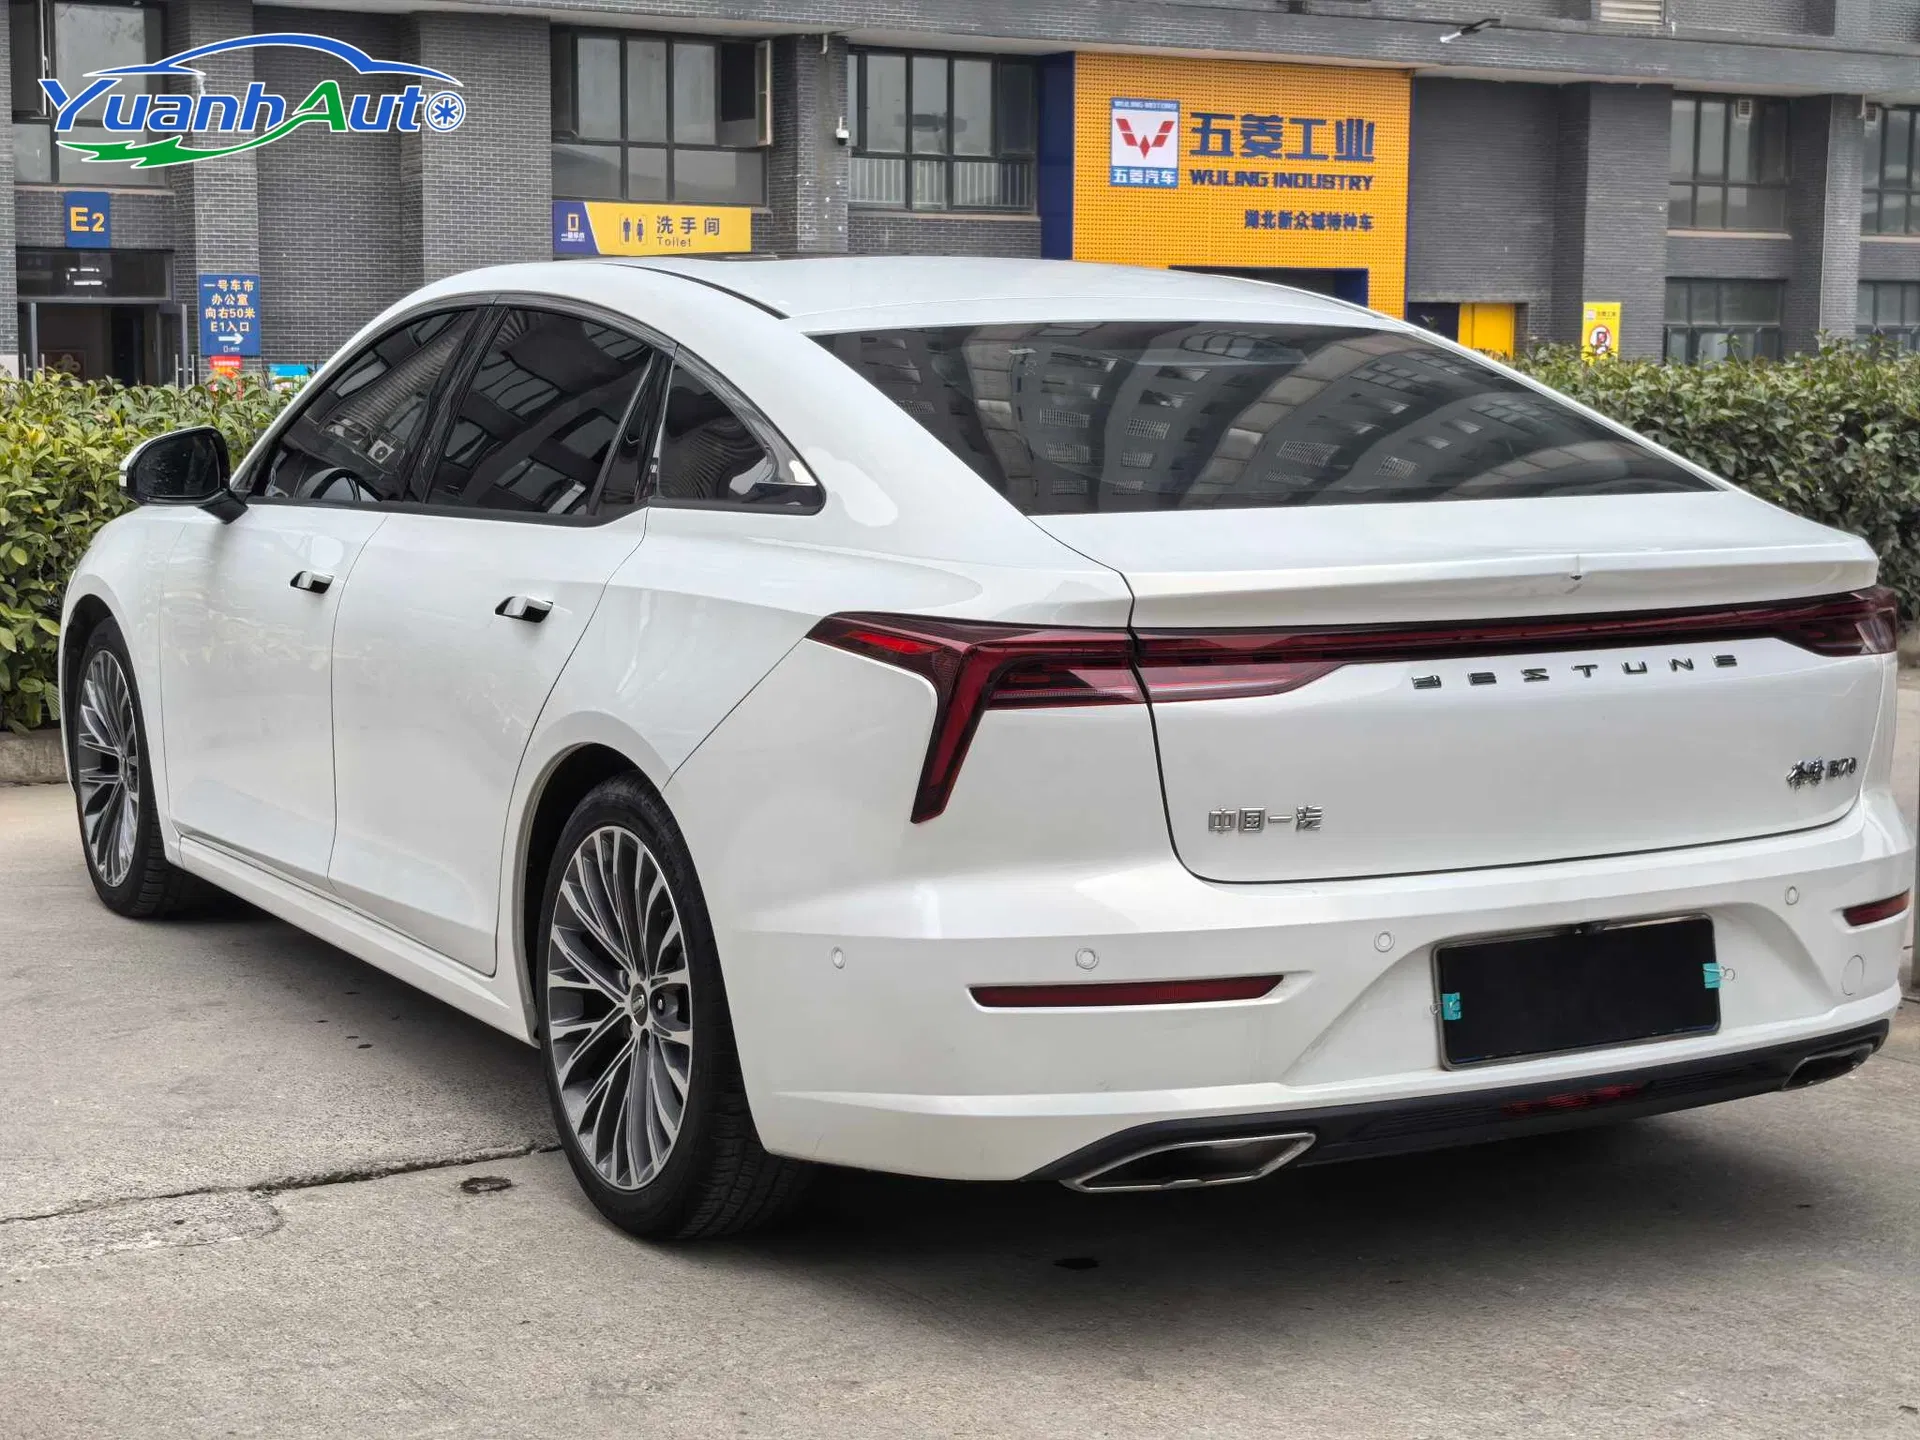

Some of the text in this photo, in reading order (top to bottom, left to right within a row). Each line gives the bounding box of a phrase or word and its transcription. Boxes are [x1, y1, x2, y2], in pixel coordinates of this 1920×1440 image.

[1189, 112, 1375, 162] 五菱工业
[1112, 168, 1177, 185] 五菱汽车
[1189, 169, 1374, 191] WULING INDUSTRY
[70, 206, 105, 233] E2
[656, 215, 721, 236] 洗手间
[656, 236, 692, 248] Toilet
[203, 279, 255, 292] 一号车市
[211, 293, 249, 306] 办公室
[205, 307, 256, 320] 向右50米
[210, 321, 250, 333] E1入口
[1411, 652, 1738, 690] BESTUNE
[1207, 805, 1323, 835] 中国一汽
